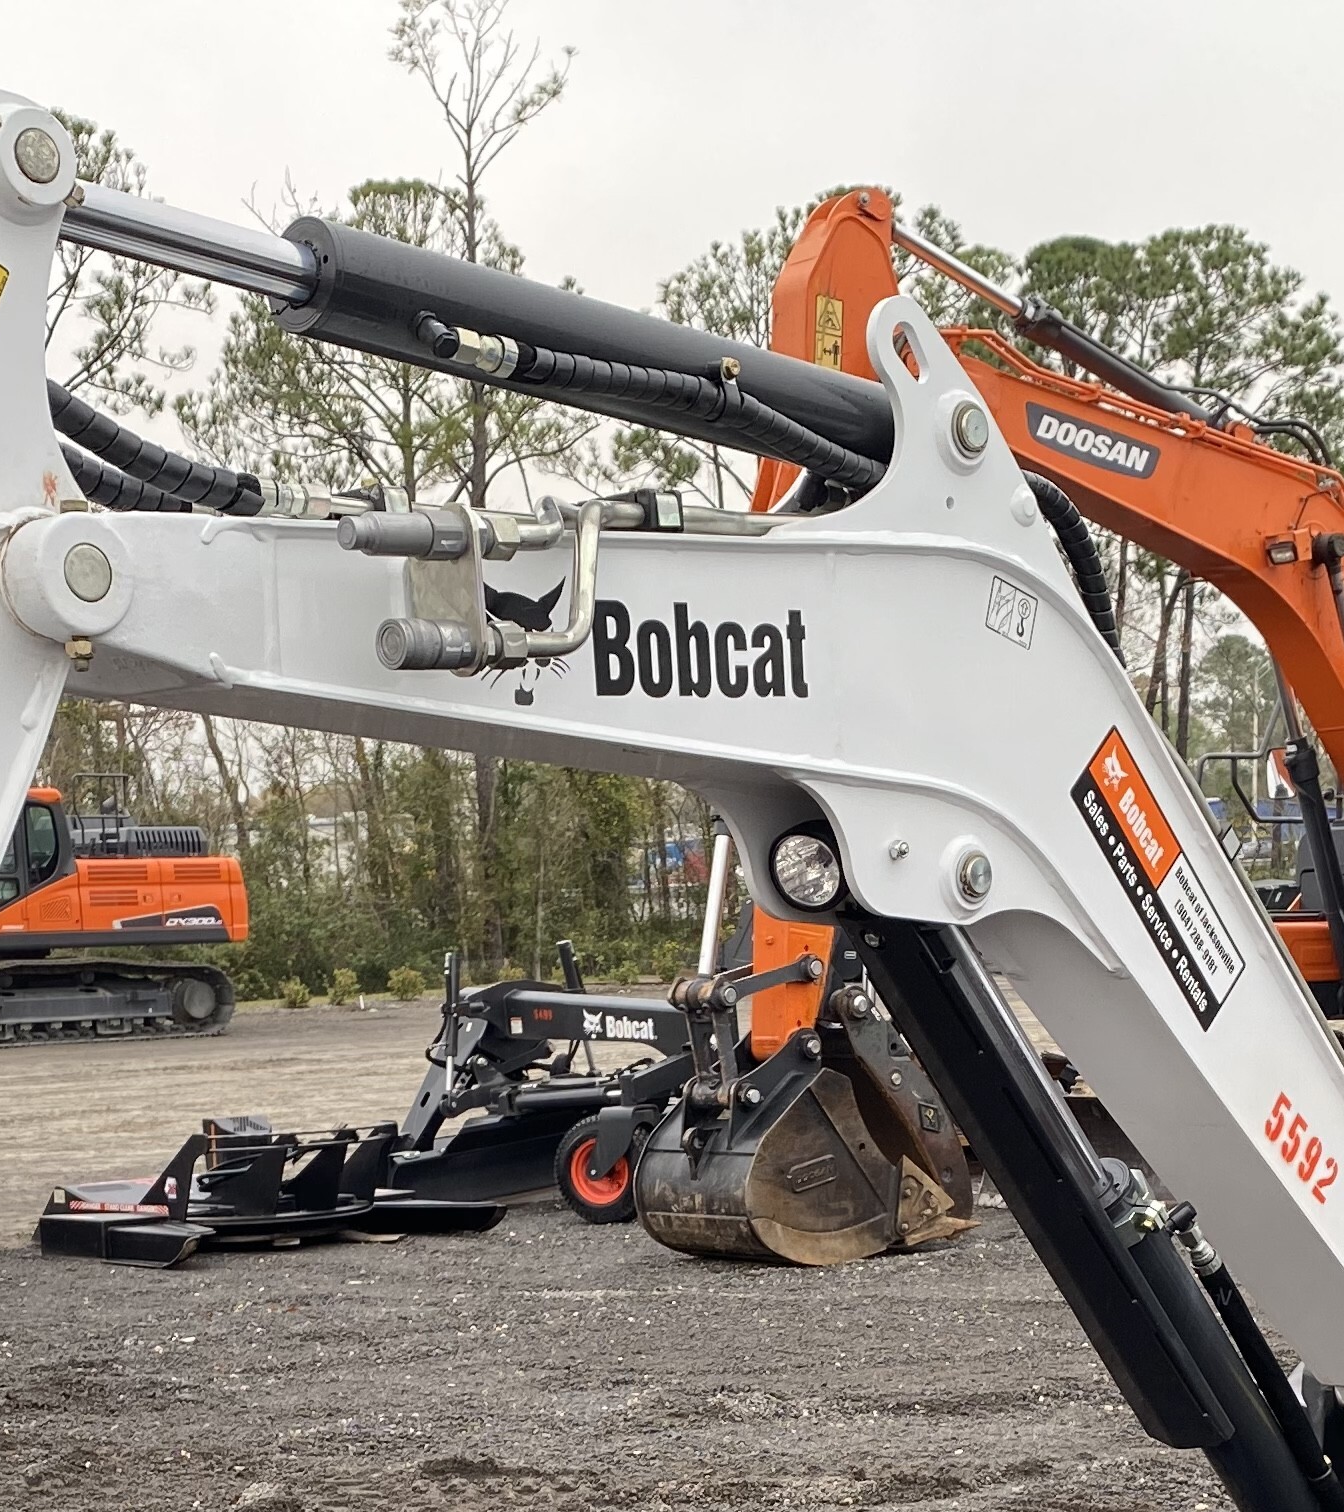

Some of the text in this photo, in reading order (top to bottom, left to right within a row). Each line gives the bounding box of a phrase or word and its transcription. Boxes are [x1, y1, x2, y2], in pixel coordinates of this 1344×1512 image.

[1036, 414, 1150, 472] DOOSAN
[593, 599, 809, 699] Bobcat
[1118, 786, 1166, 869] Bobcat
[1083, 789, 1209, 1014] Sales Parts Service Rentals
[1175, 866, 1235, 975] Bobcat of Jacksonville
[605, 1015, 656, 1040] Bobcat
[1264, 1091, 1339, 1205] 5592
